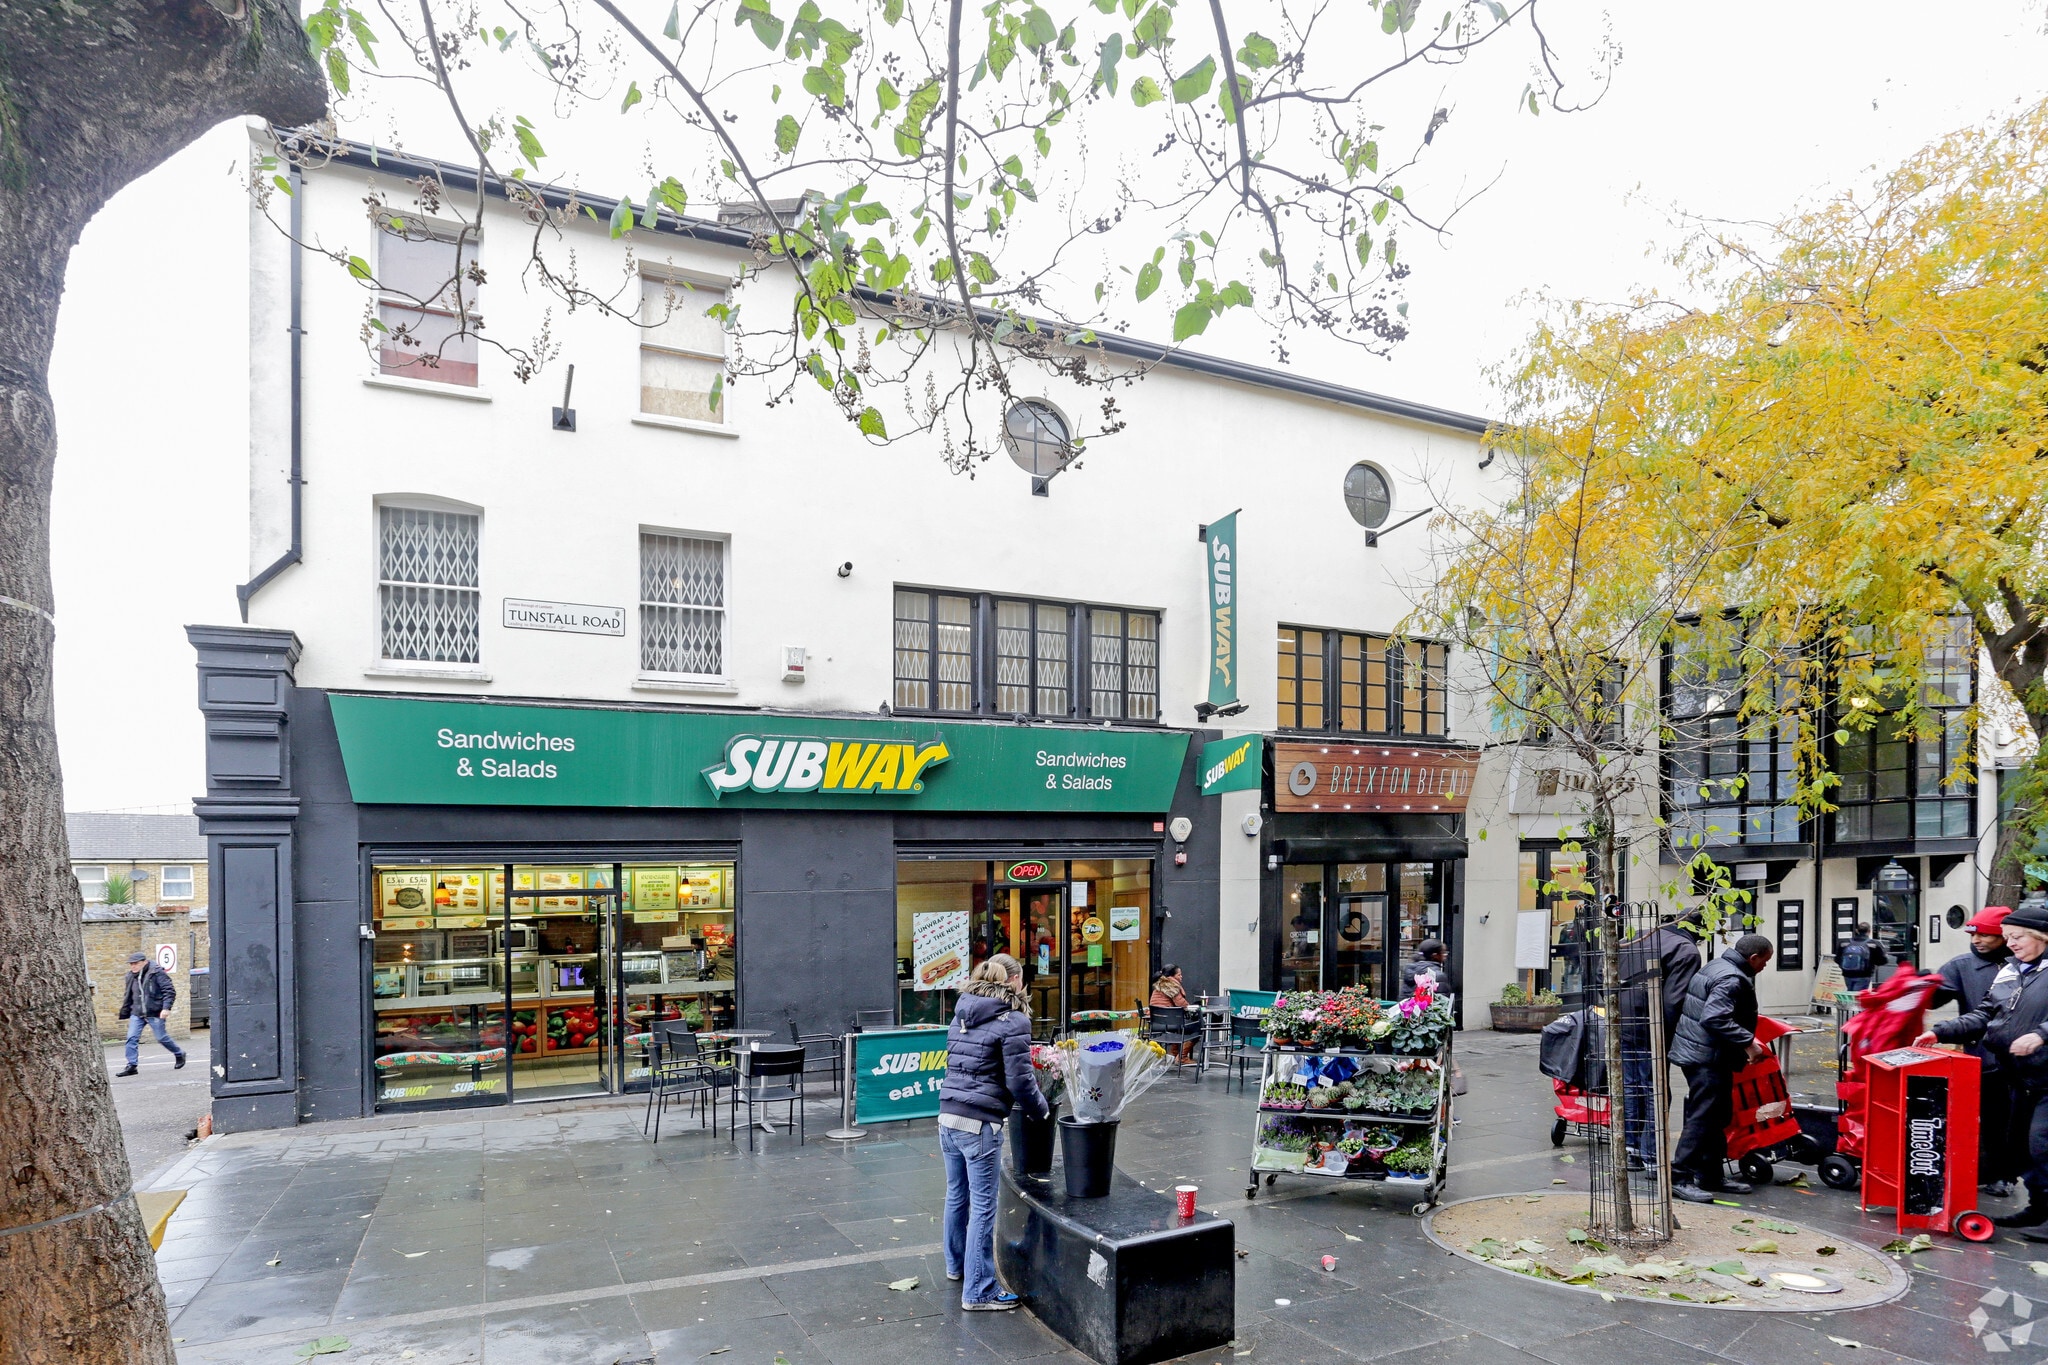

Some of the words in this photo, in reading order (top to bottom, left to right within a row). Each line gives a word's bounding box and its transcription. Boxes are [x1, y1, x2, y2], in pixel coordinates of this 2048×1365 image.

[508, 609, 578, 626] TUNSTALL
[582, 615, 620, 629] ROAD
[1212, 535, 1232, 688] SUBWAY
[437, 728, 575, 752] Sandwiches
[456, 757, 474, 777] &
[481, 757, 558, 779] Salads
[708, 738, 950, 791] SUBWAY
[1035, 750, 1127, 769] Sandwiches
[1203, 741, 1251, 789] SUBWAY
[1045, 773, 1057, 790] &
[1061, 773, 1113, 791] Salads
[1330, 765, 1411, 794] BRIXTON
[1416, 767, 1469, 796] BLEND
[1013, 864, 1043, 878] OPEN
[1890, 871, 1896, 879] 2
[918, 915, 945, 934] UNWRAP
[933, 930, 946, 942] THE
[946, 923, 960, 934] NEW
[164, 953, 170, 964] 5
[918, 949, 944, 966] FESTIVE
[944, 938, 963, 952] FEAST
[871, 1049, 949, 1077] SUBWA
[380, 1084, 433, 1100] SUBWAY
[450, 1078, 501, 1093] SUBWAY
[888, 1081, 923, 1101] eat
